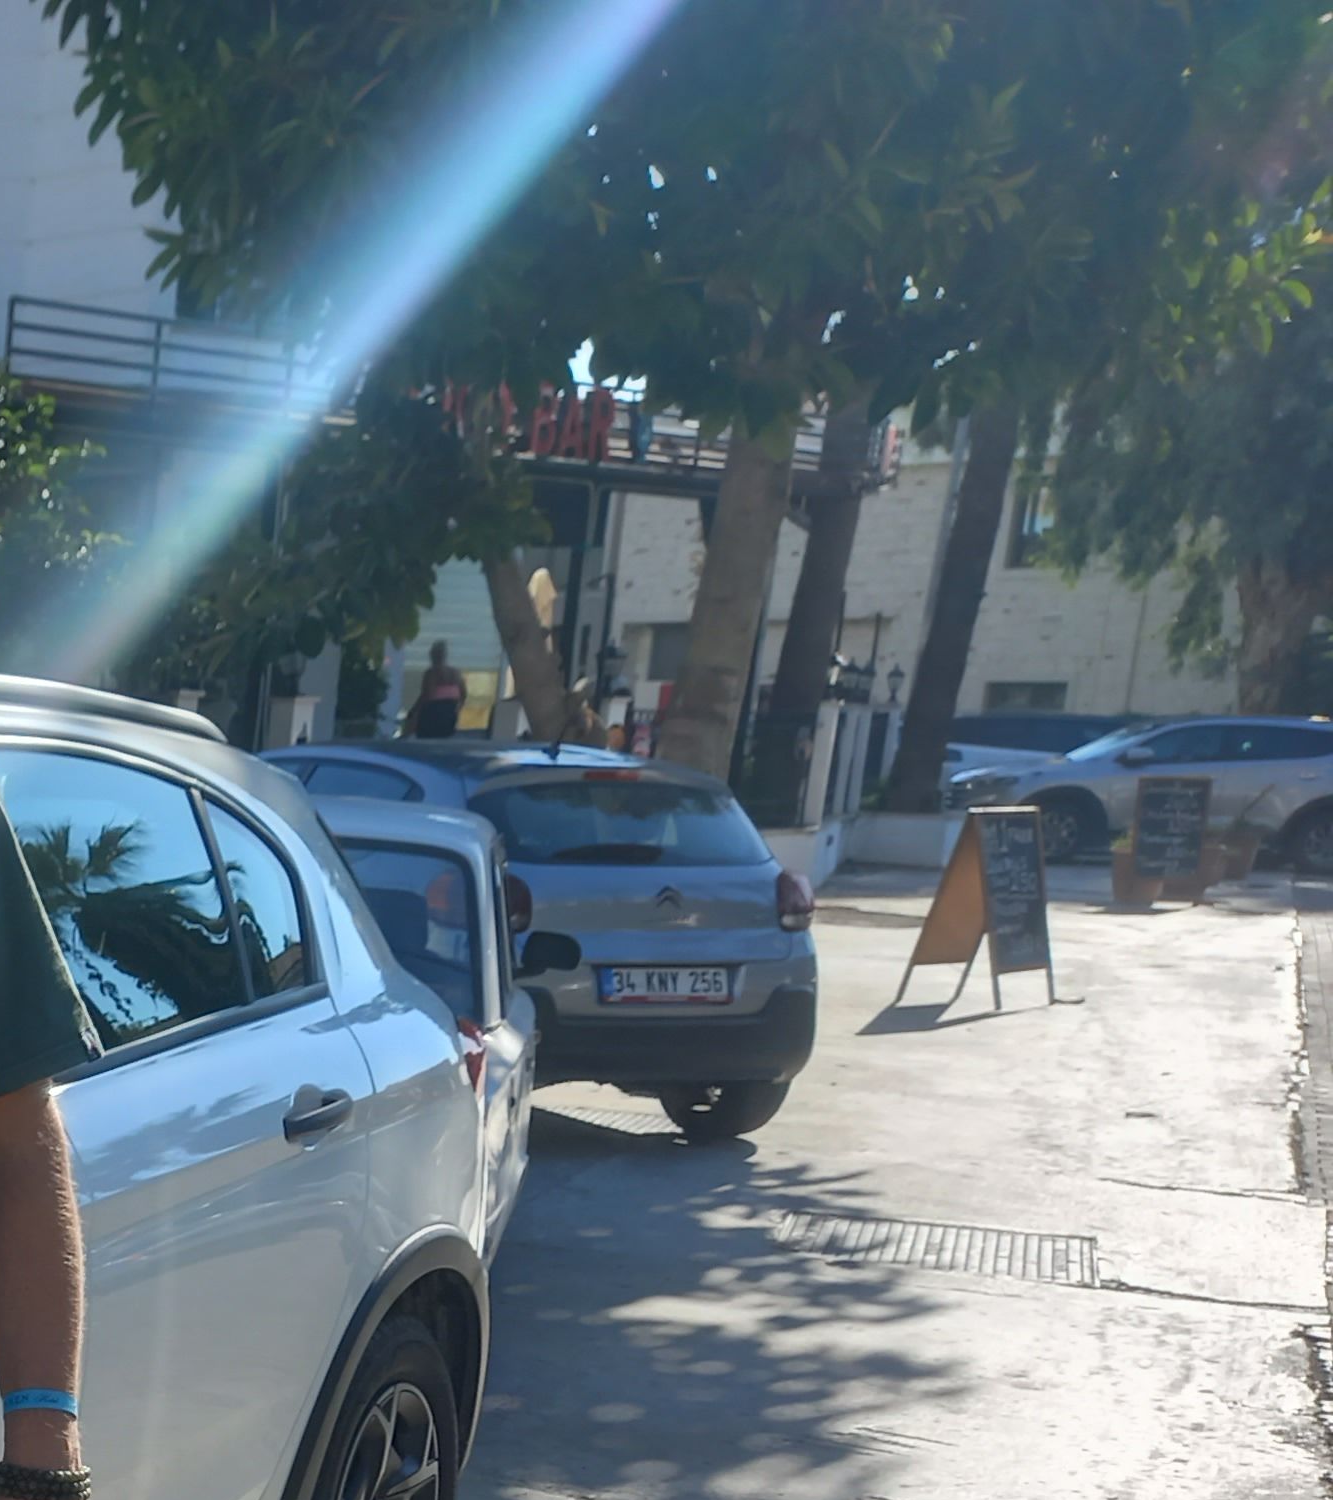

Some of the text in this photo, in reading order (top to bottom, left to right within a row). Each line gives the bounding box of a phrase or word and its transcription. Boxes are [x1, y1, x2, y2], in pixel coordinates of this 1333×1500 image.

[612, 970, 723, 993] 34 KNY 256
